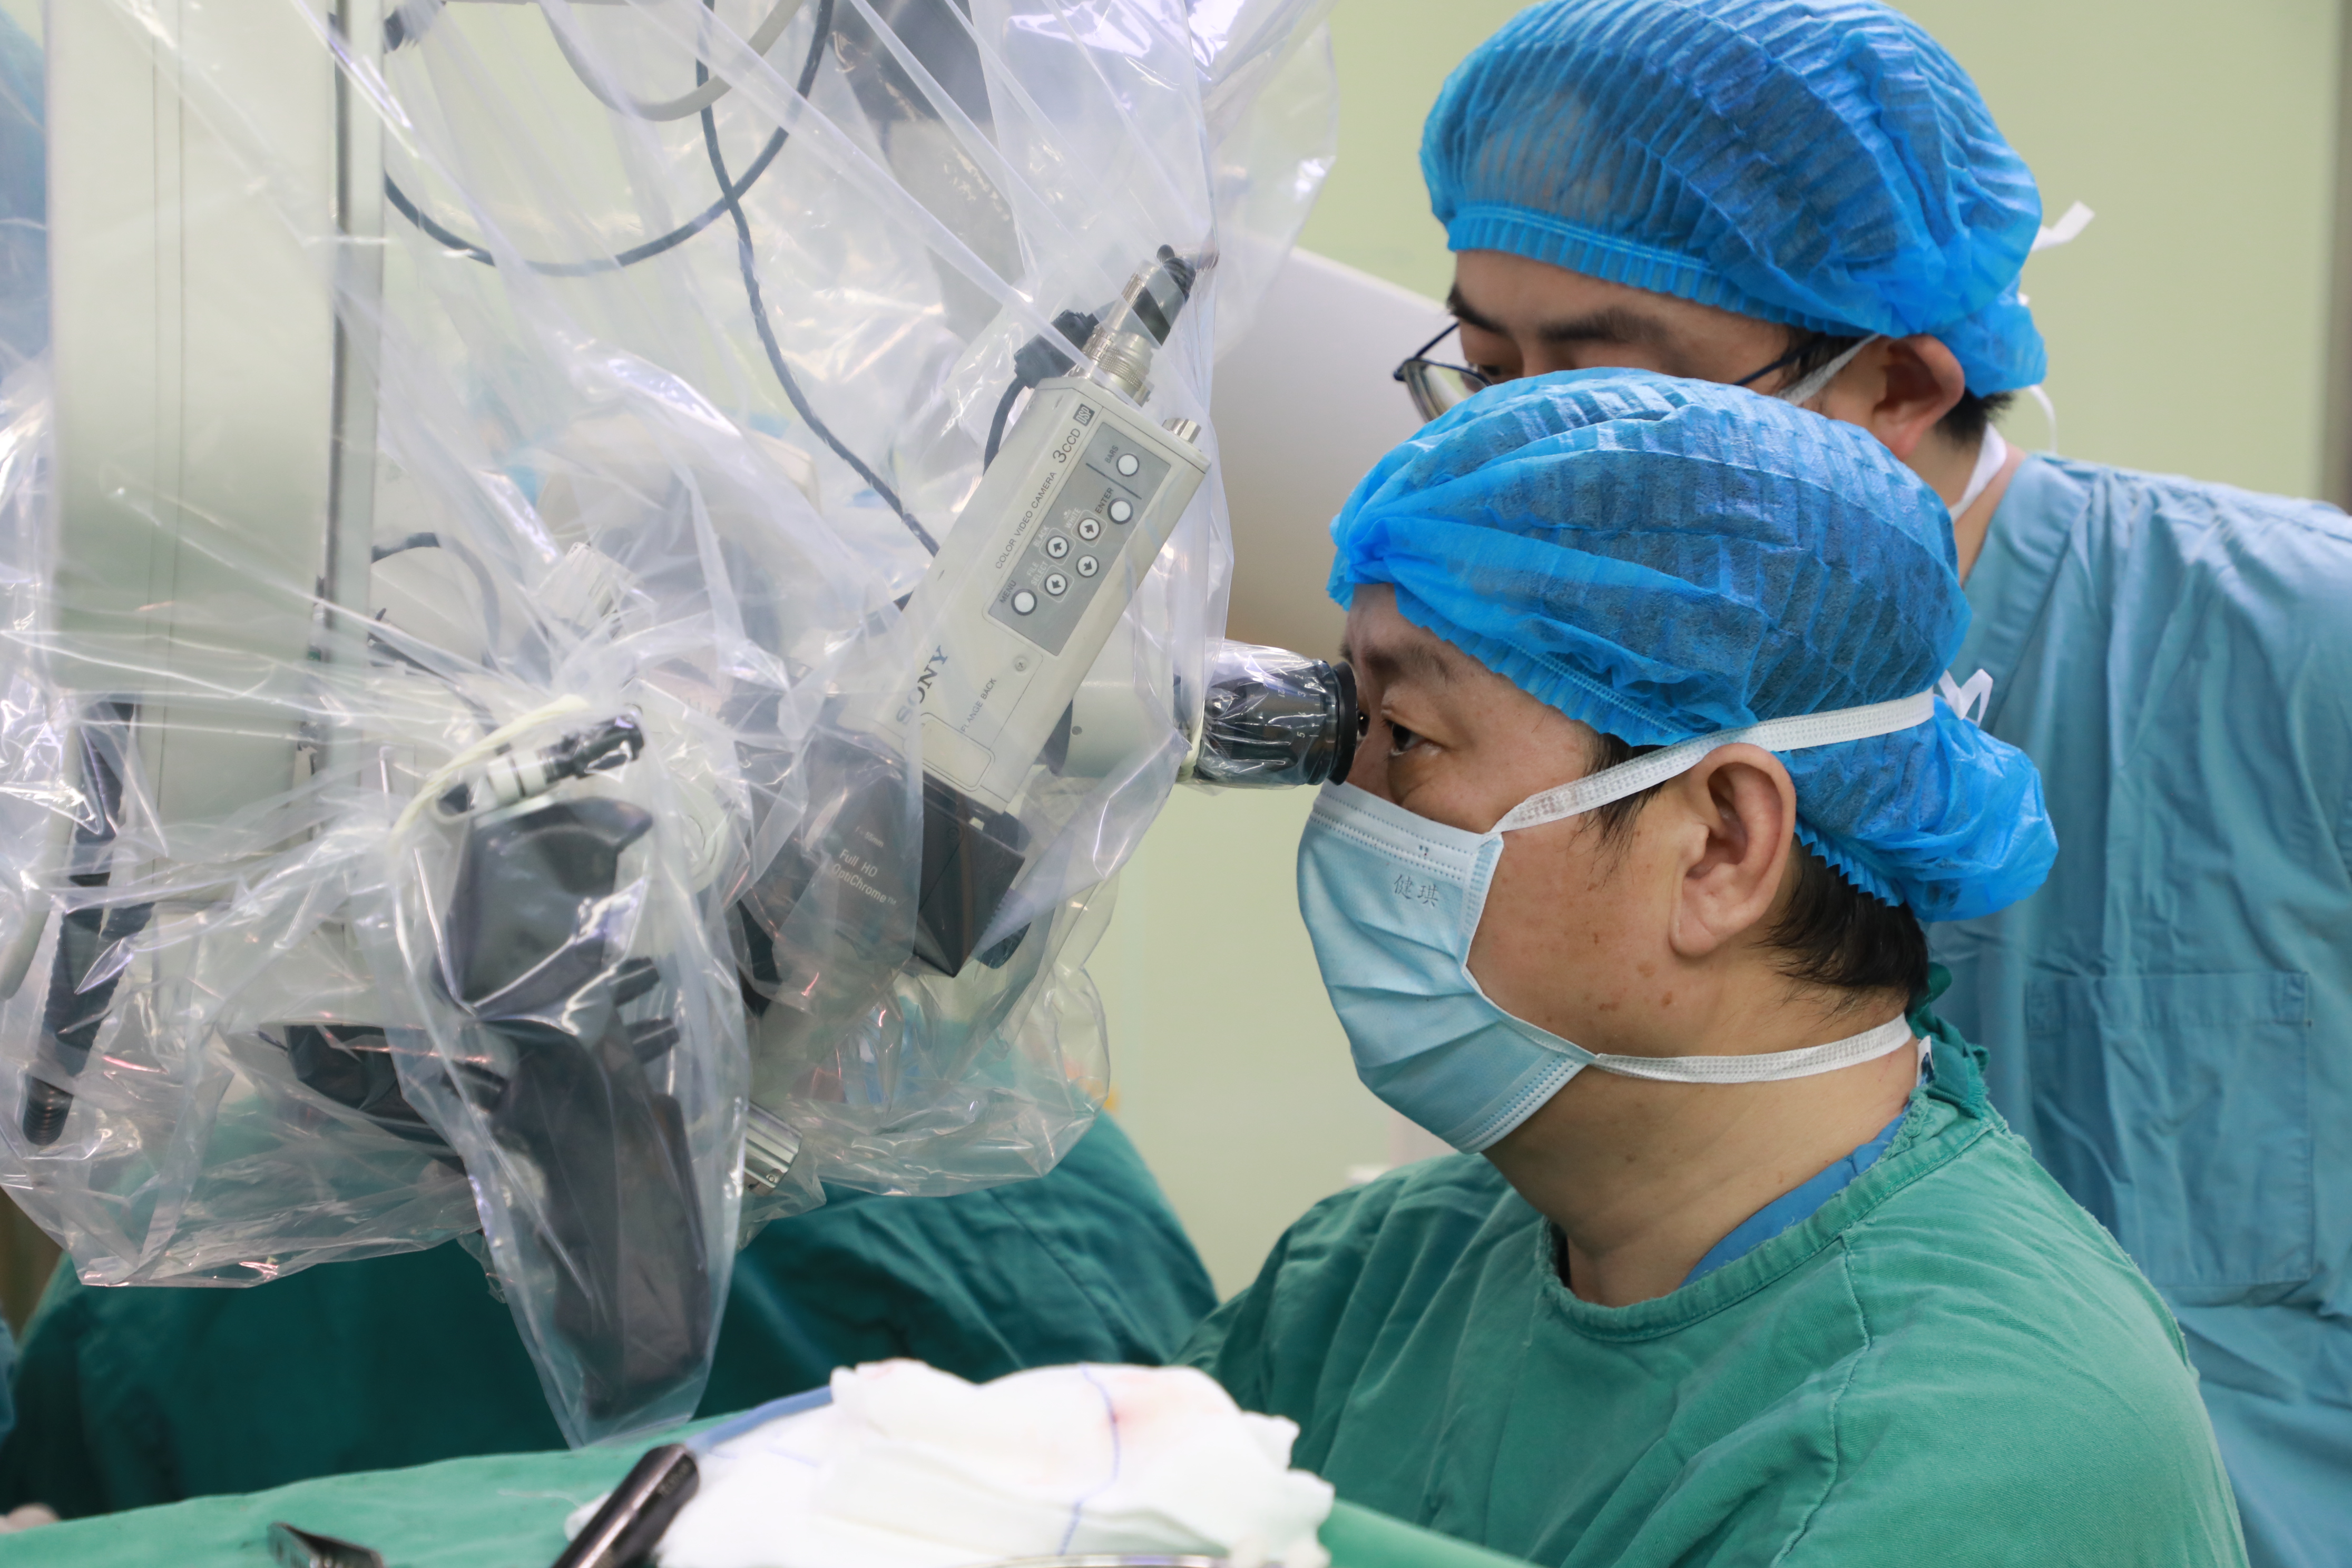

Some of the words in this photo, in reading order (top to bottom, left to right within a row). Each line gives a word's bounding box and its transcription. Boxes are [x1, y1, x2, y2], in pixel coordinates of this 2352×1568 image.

[1075, 406, 1092, 425] DSP
[1053, 428, 1081, 464] 3CCD
[1104, 445, 1119, 464] BARS
[1095, 487, 1114, 514] ENTER
[995, 538, 1016, 569] COLOR
[1014, 510, 1033, 537] VIDEO
[1031, 472, 1057, 508] CAMERA
[1065, 507, 1081, 528] WHITE
[1033, 525, 1050, 547] BLACK
[1026, 561, 1040, 577] FILE
[1031, 561, 1049, 586] SELECT
[999, 580, 1016, 604] MENU
[896, 645, 948, 726] SONY
[961, 701, 983, 733] FLANGE
[981, 678, 997, 700] BACK
[839, 848, 859, 867] Full
[860, 861, 878, 878] HD
